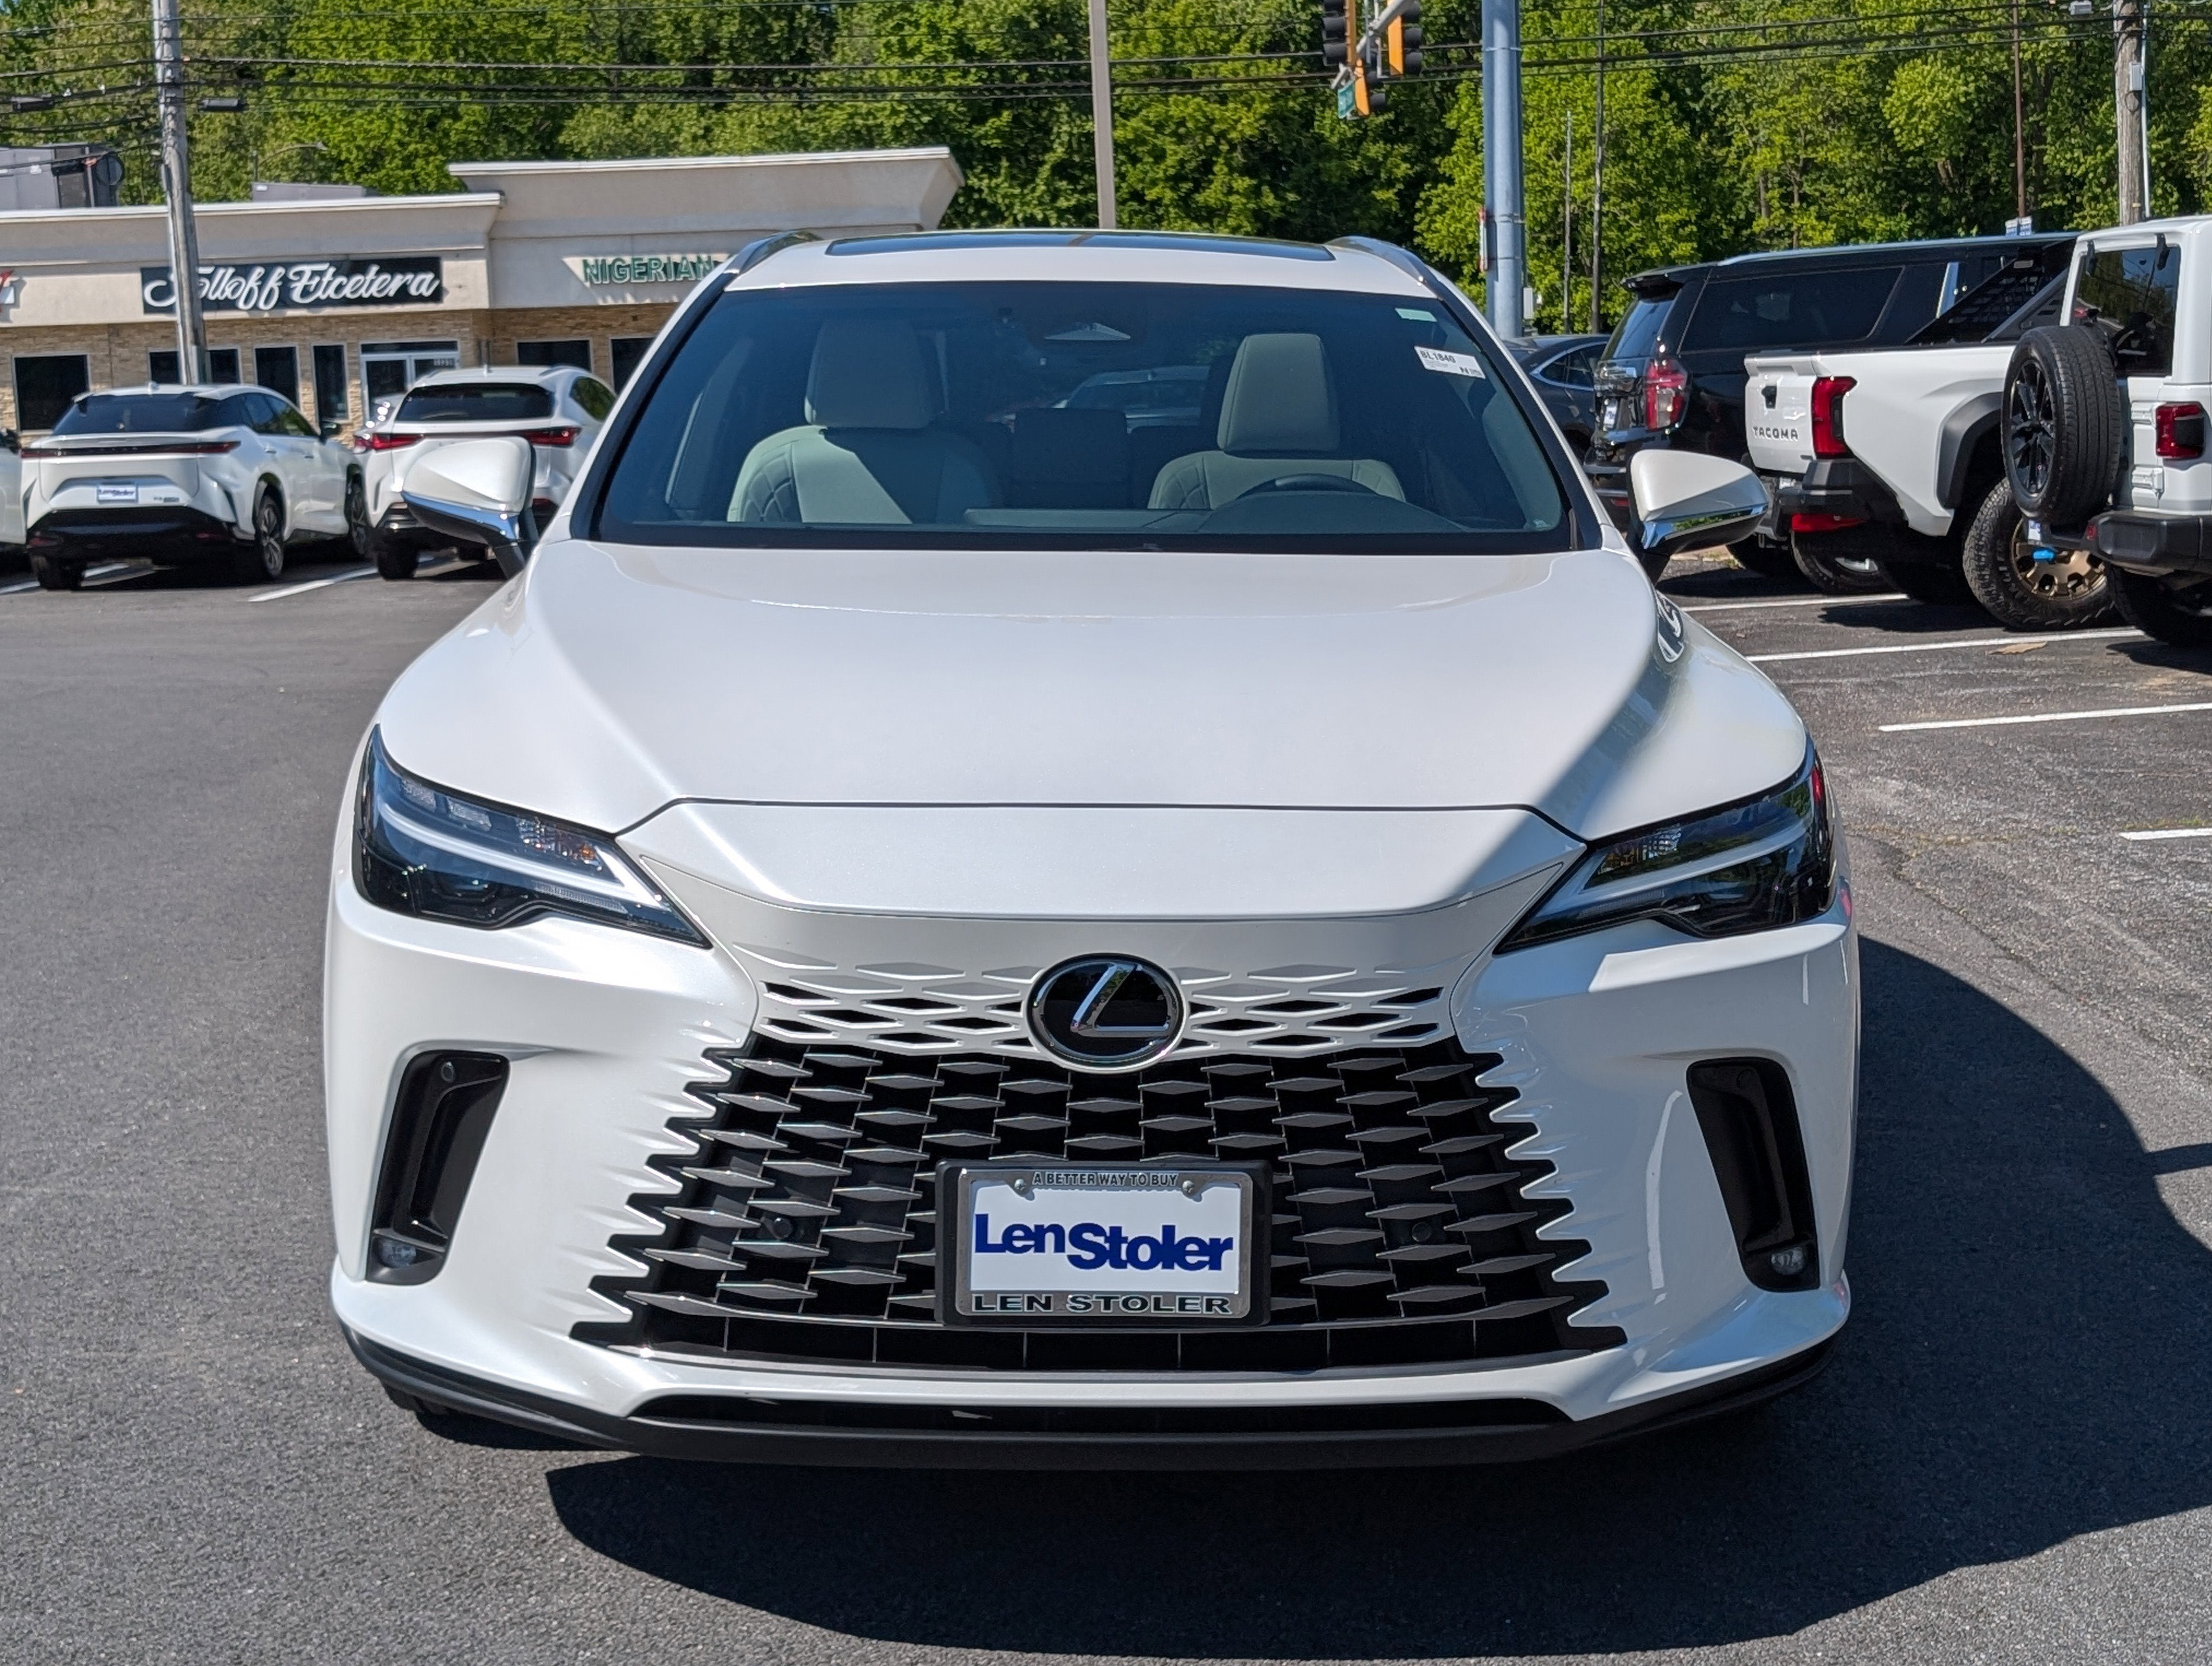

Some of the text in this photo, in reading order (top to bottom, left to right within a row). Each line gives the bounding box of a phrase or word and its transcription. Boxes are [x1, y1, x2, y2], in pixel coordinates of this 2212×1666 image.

[582, 254, 715, 284] NIGERIAN
[288, 262, 440, 304] Etcetera
[1752, 426, 1798, 440] TACOMA
[1032, 1171, 1178, 1186] A BETTER WAY TO BUY
[972, 1293, 1233, 1315] LEN STOLER
